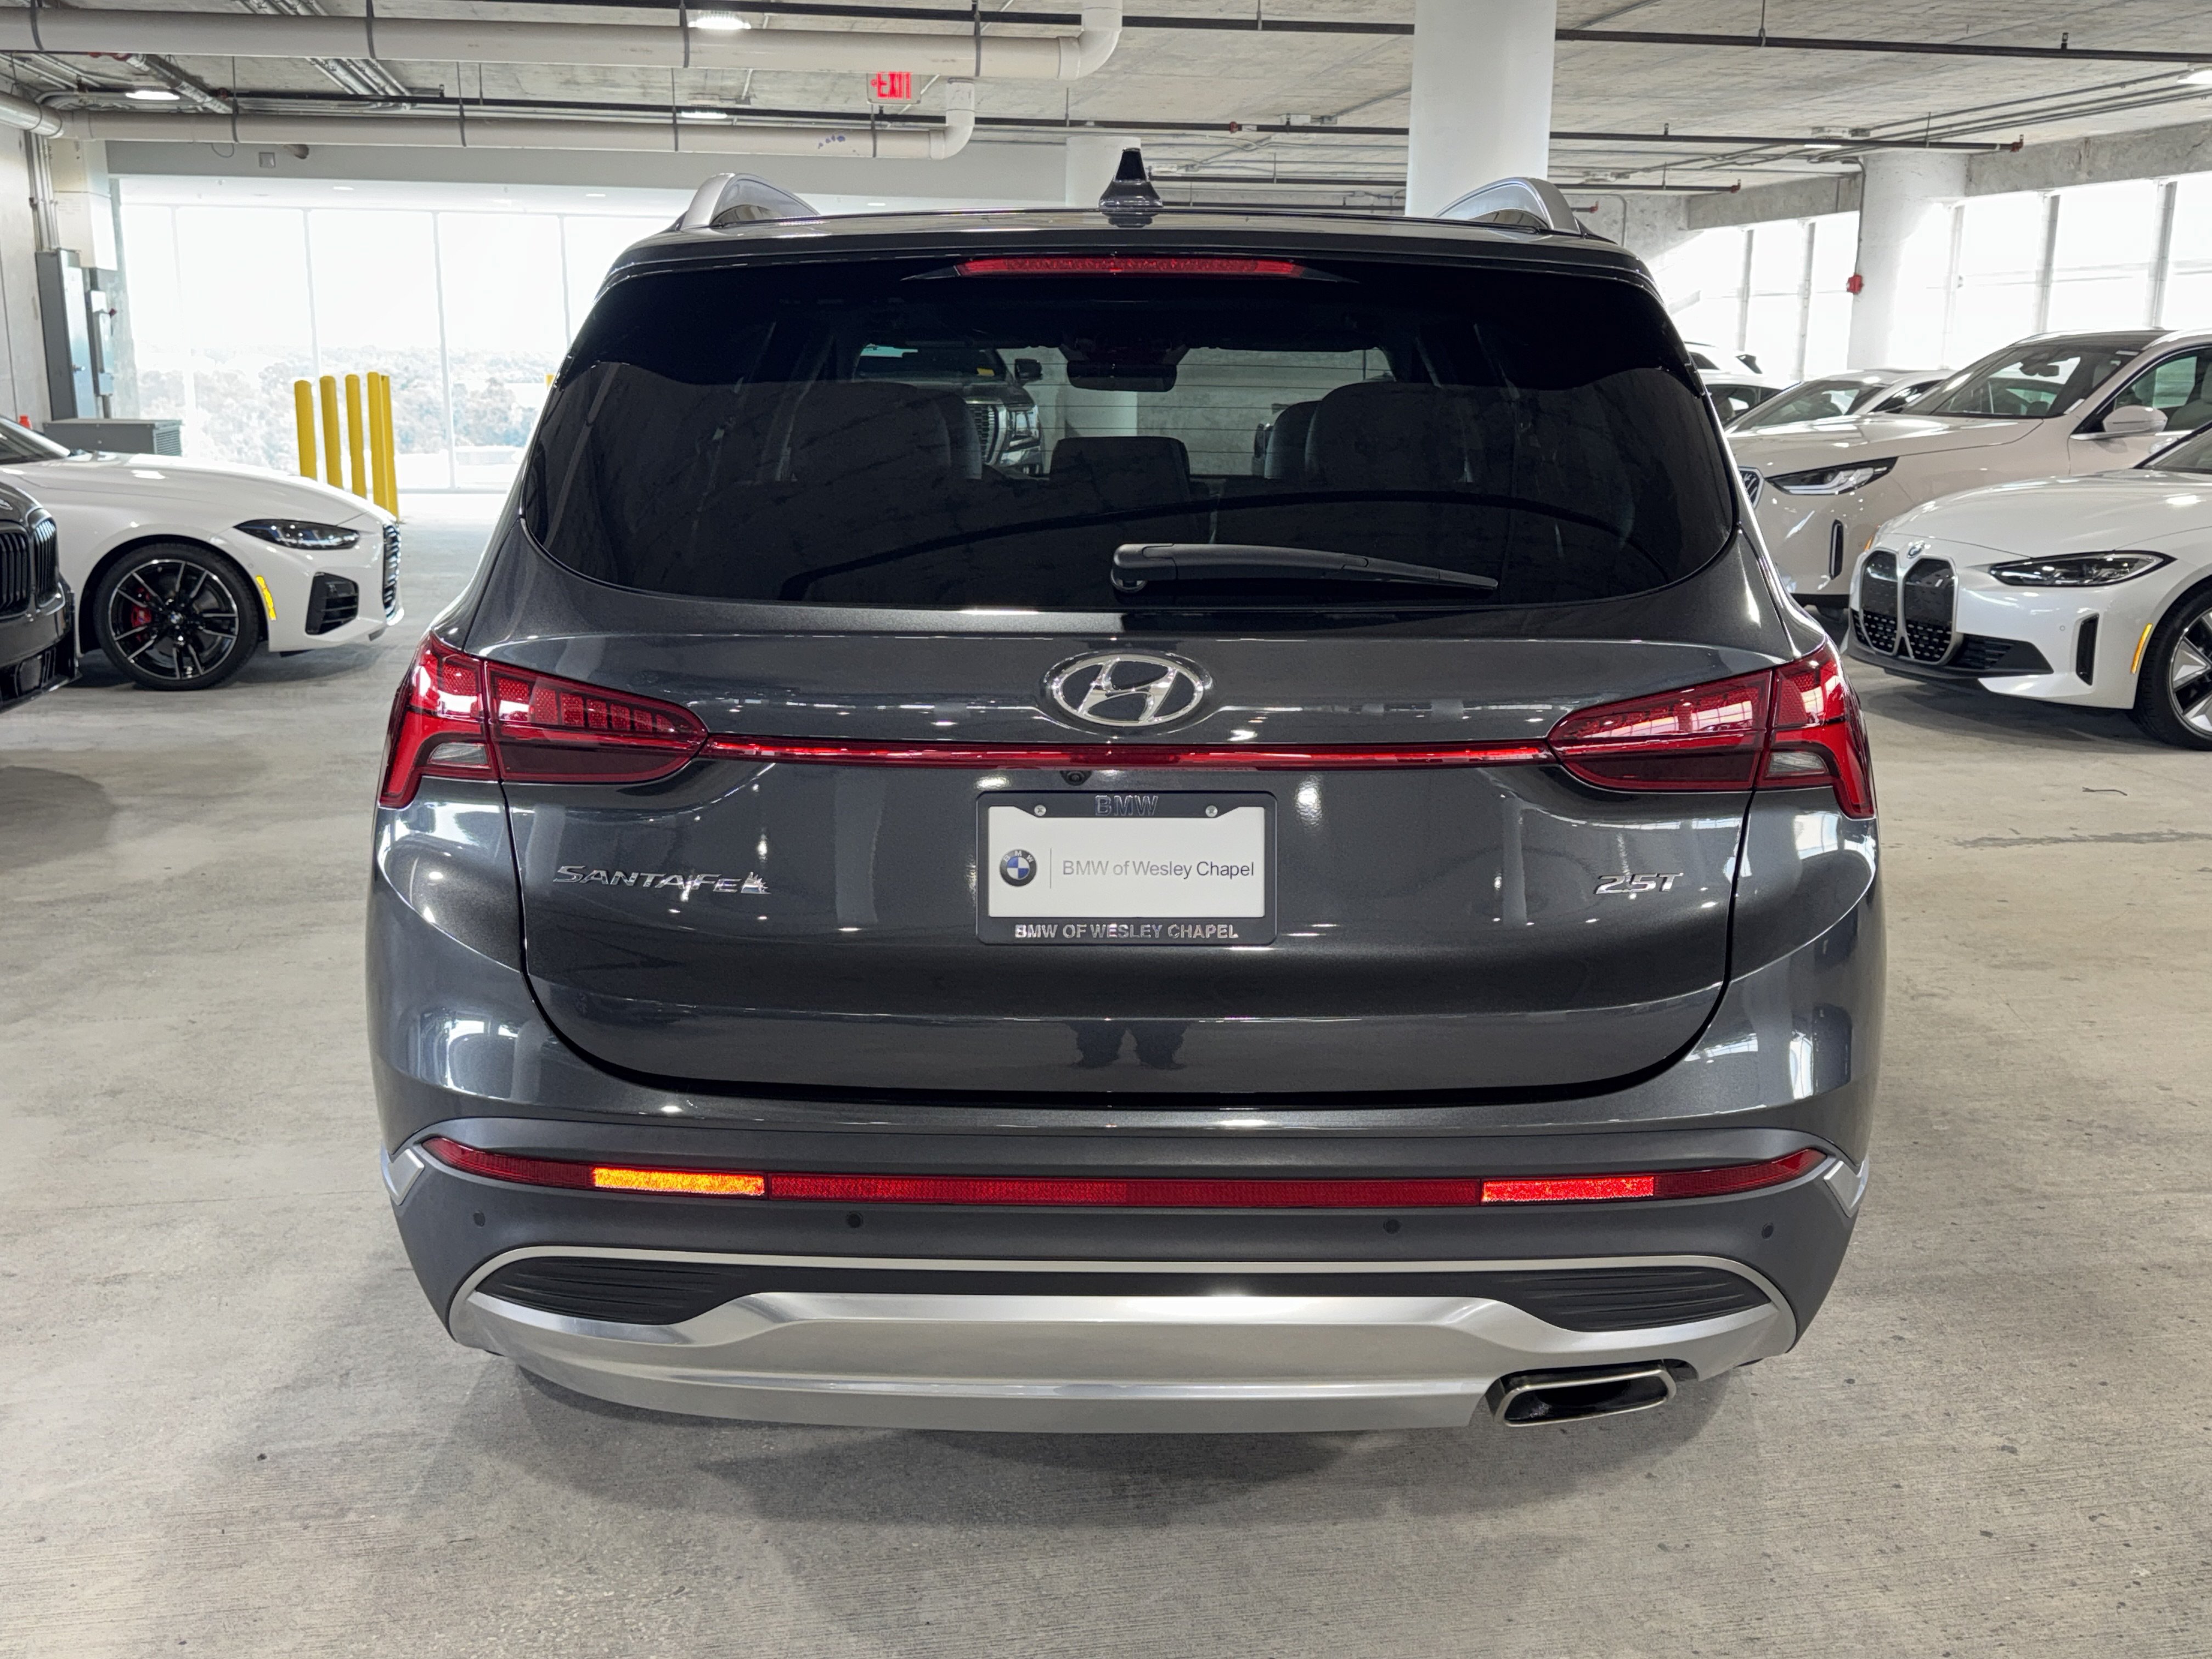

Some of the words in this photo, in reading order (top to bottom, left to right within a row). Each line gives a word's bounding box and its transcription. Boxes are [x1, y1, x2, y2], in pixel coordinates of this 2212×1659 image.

[1095, 794, 1159, 817] BMW
[1063, 860, 1110, 876] BMW
[1113, 860, 1130, 876] of
[1132, 860, 1193, 880] Wesley
[1197, 861, 1254, 880] Chapel
[1015, 924, 1058, 938] BMW
[1063, 924, 1087, 938] OF
[1091, 924, 1163, 939] WESLEY
[1167, 924, 1239, 939] CHAPEL
